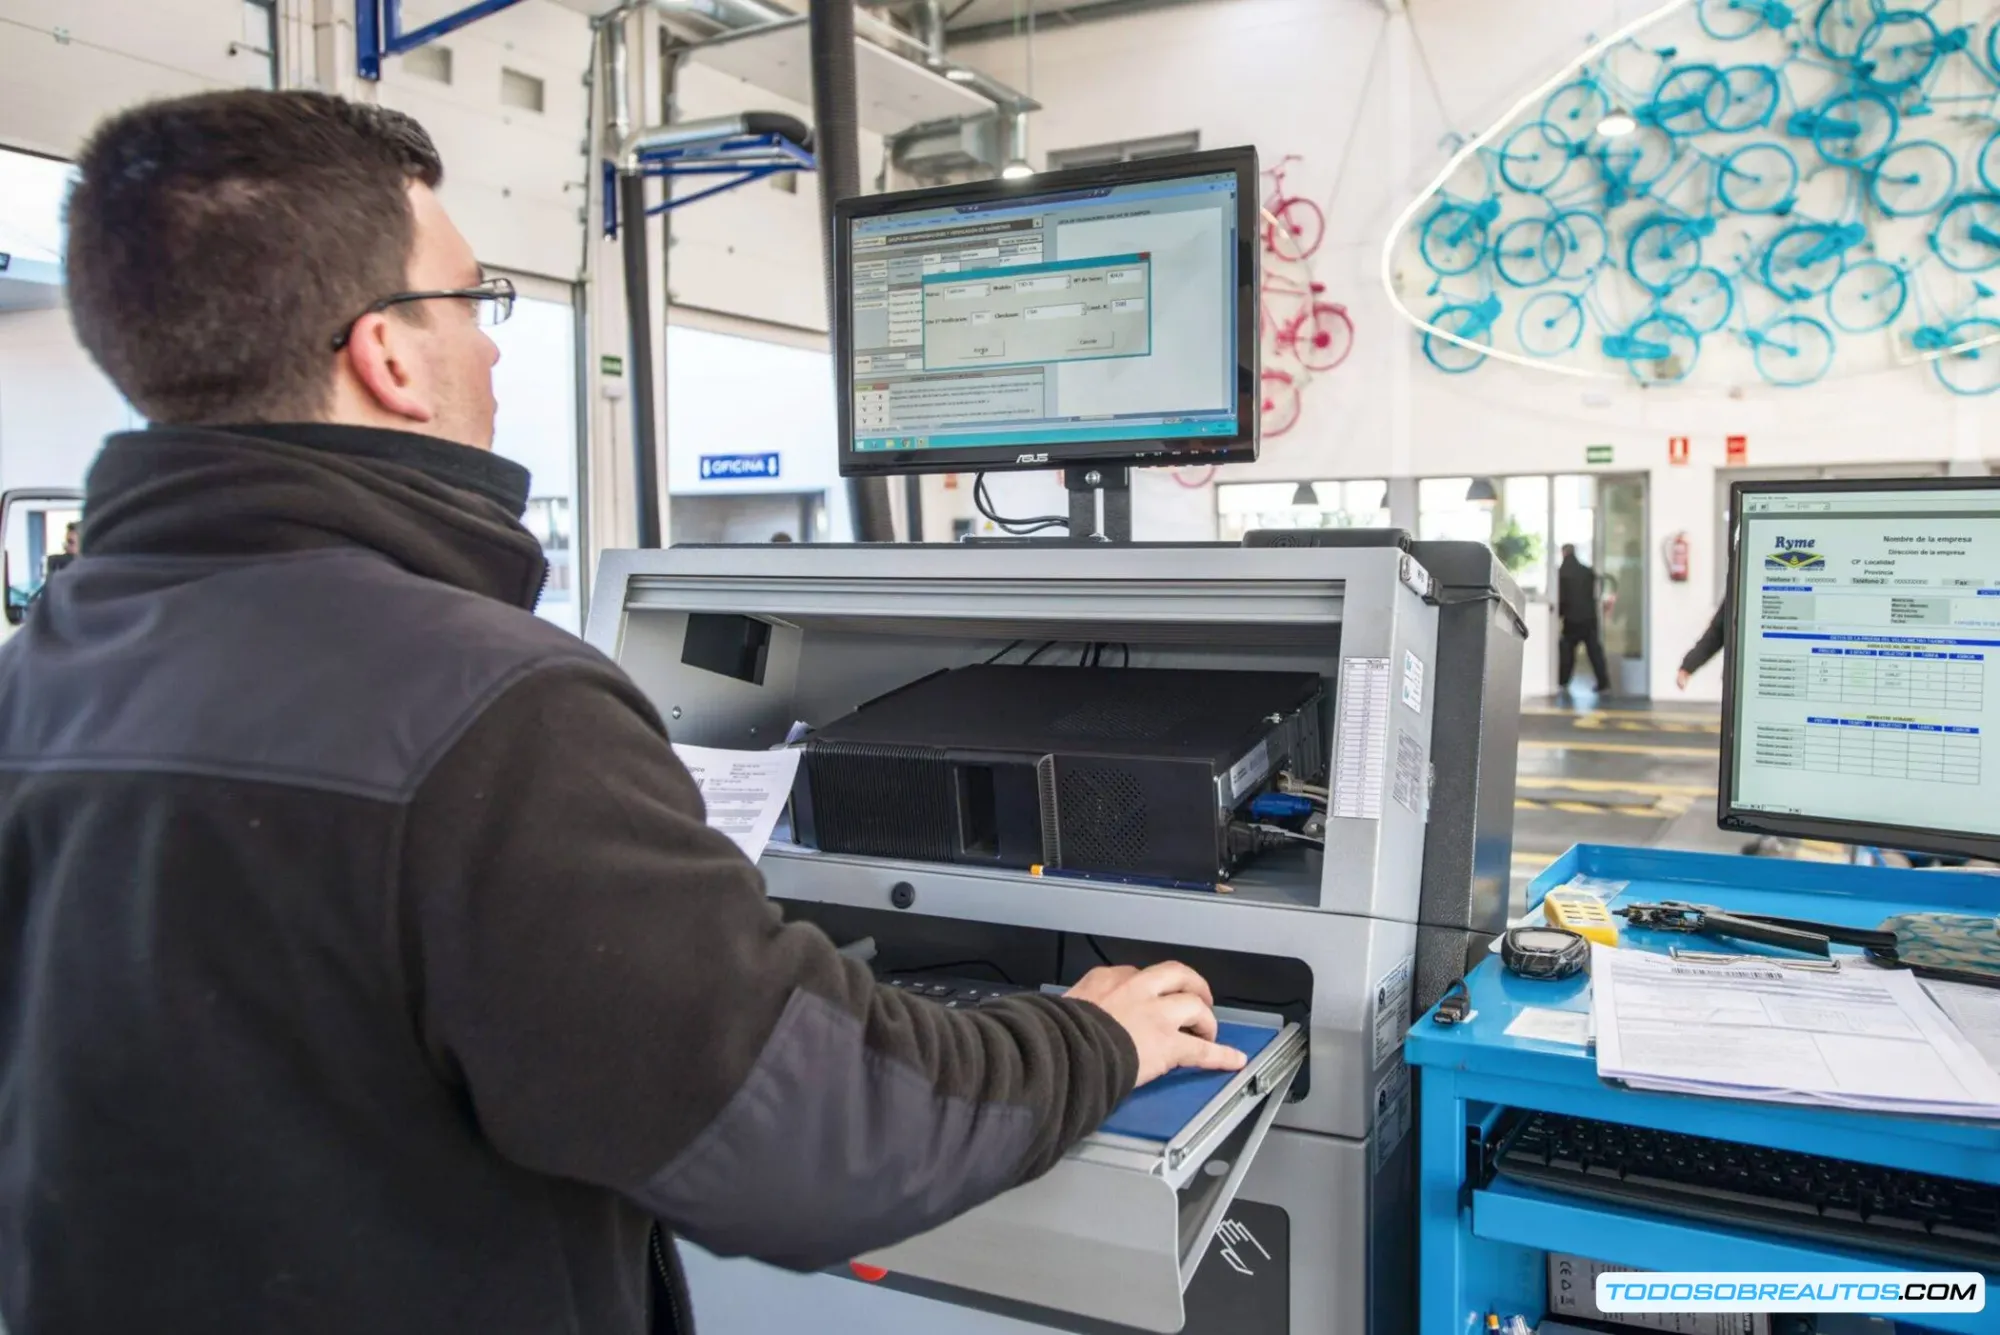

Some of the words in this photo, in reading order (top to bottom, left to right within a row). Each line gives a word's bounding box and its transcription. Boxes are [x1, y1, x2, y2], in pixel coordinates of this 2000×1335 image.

[1016, 453, 1049, 464] ASUS
[712, 459, 765, 474] OFICINA
[1775, 535, 1816, 550] Ryme
[1937, 536, 1972, 544] empresa
